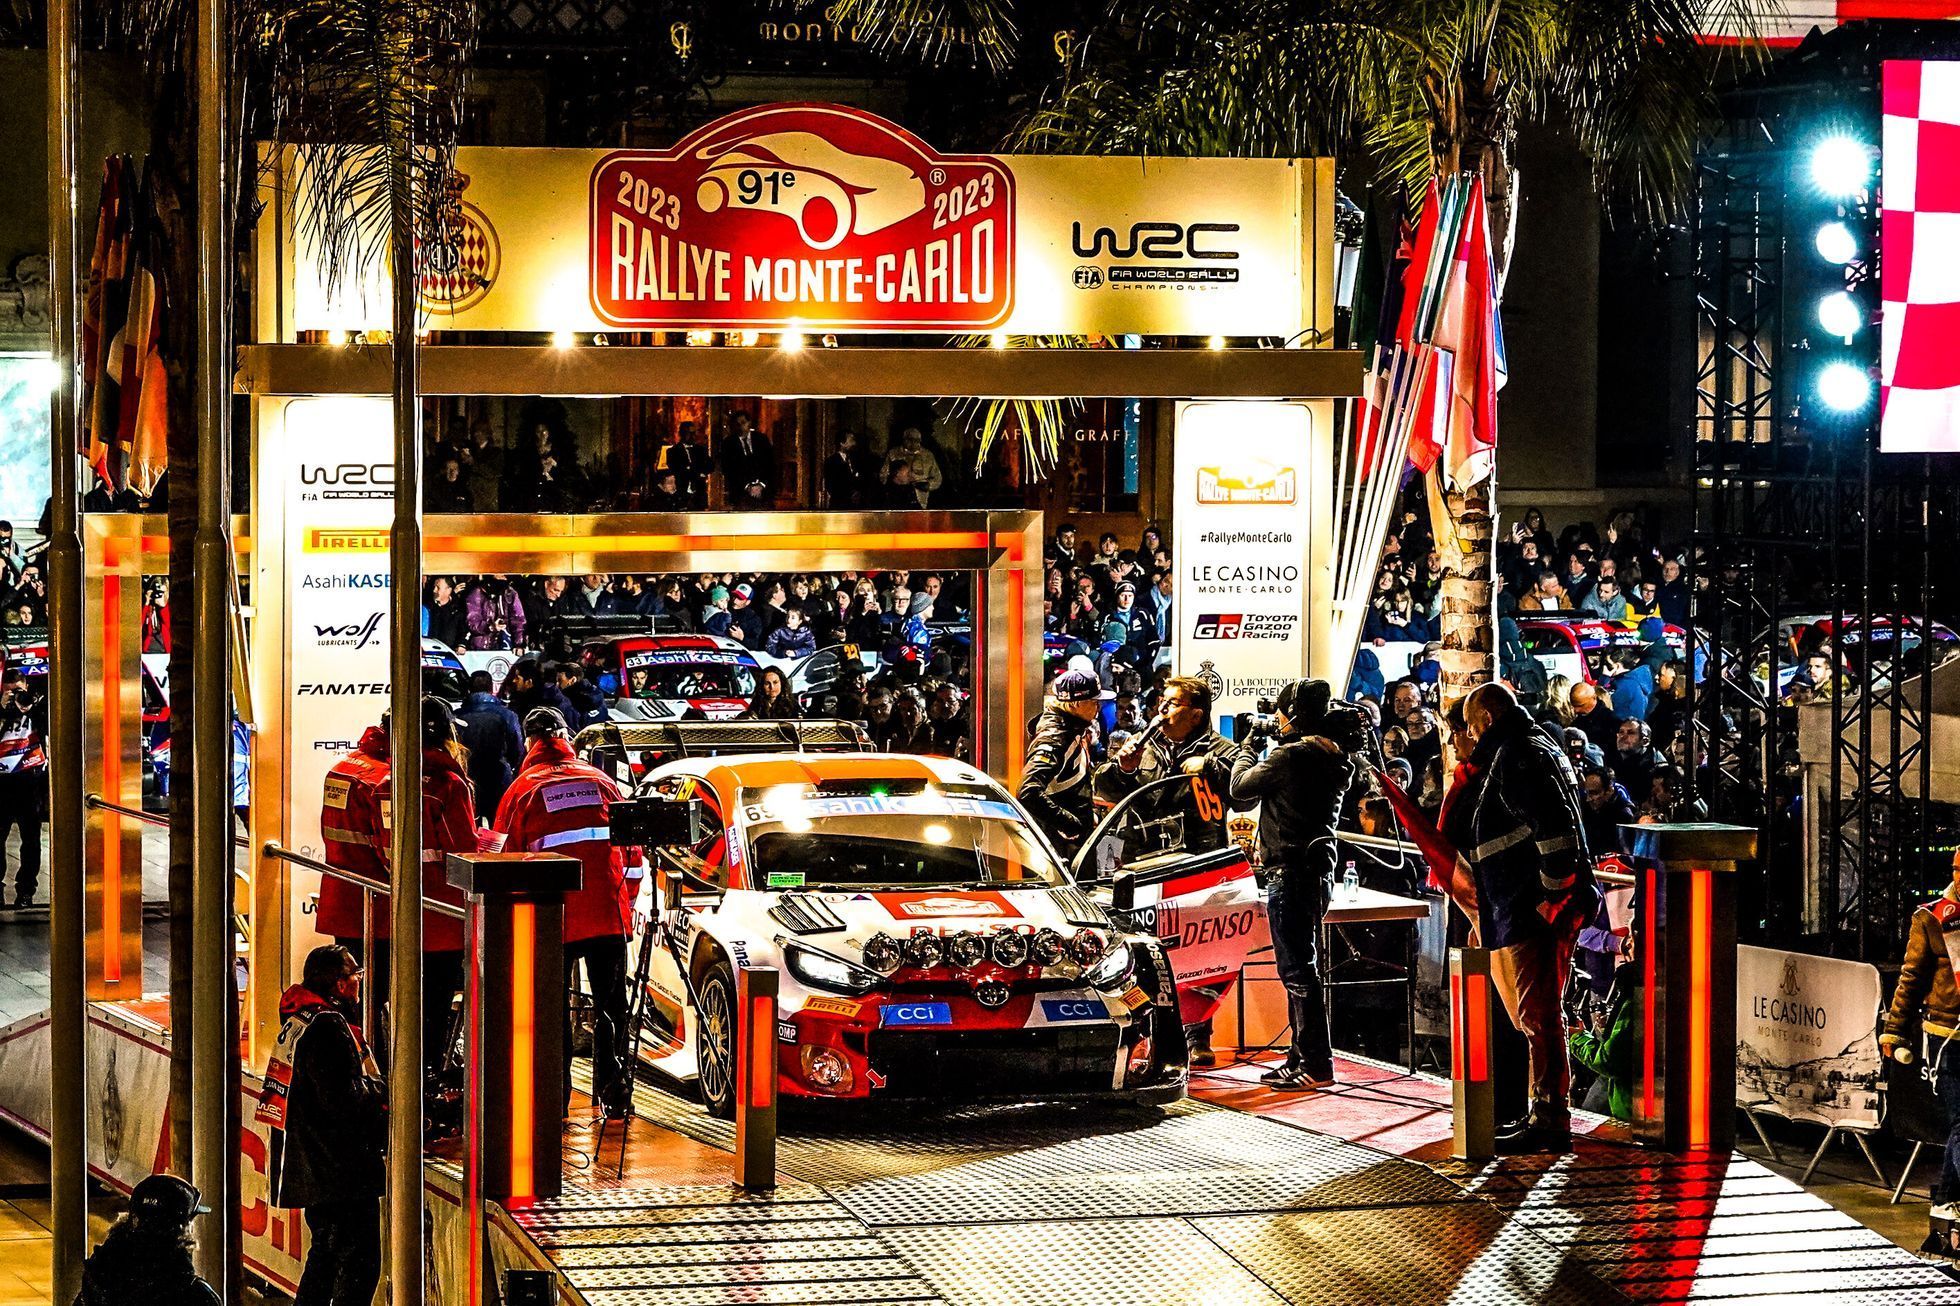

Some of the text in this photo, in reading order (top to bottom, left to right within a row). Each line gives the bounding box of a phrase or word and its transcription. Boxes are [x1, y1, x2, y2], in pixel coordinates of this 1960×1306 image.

[617, 171, 681, 231] 2023
[933, 172, 994, 230] 2023
[1072, 221, 1240, 259] WRC
[611, 211, 994, 303] RALLYE MONTE-CARLO
[1111, 269, 1237, 280] FIA WORLD RALLY
[1200, 532, 1293, 545] #RallyeMonteCarlo
[1193, 565, 1298, 581] LE CASINO
[1246, 614, 1298, 622] TOYOTA
[1243, 622, 1292, 631] GAZOO
[1241, 630, 1290, 641] Racing
[627, 657, 642, 667] 33
[1233, 678, 1245, 687] LA
[1181, 909, 1254, 948] DENSO
[1176, 970, 1203, 981] GAZOO
[806, 997, 857, 1015] PIRELLI
[1753, 995, 1827, 1030] LE CASINO
[778, 1025, 796, 1039] OMP
